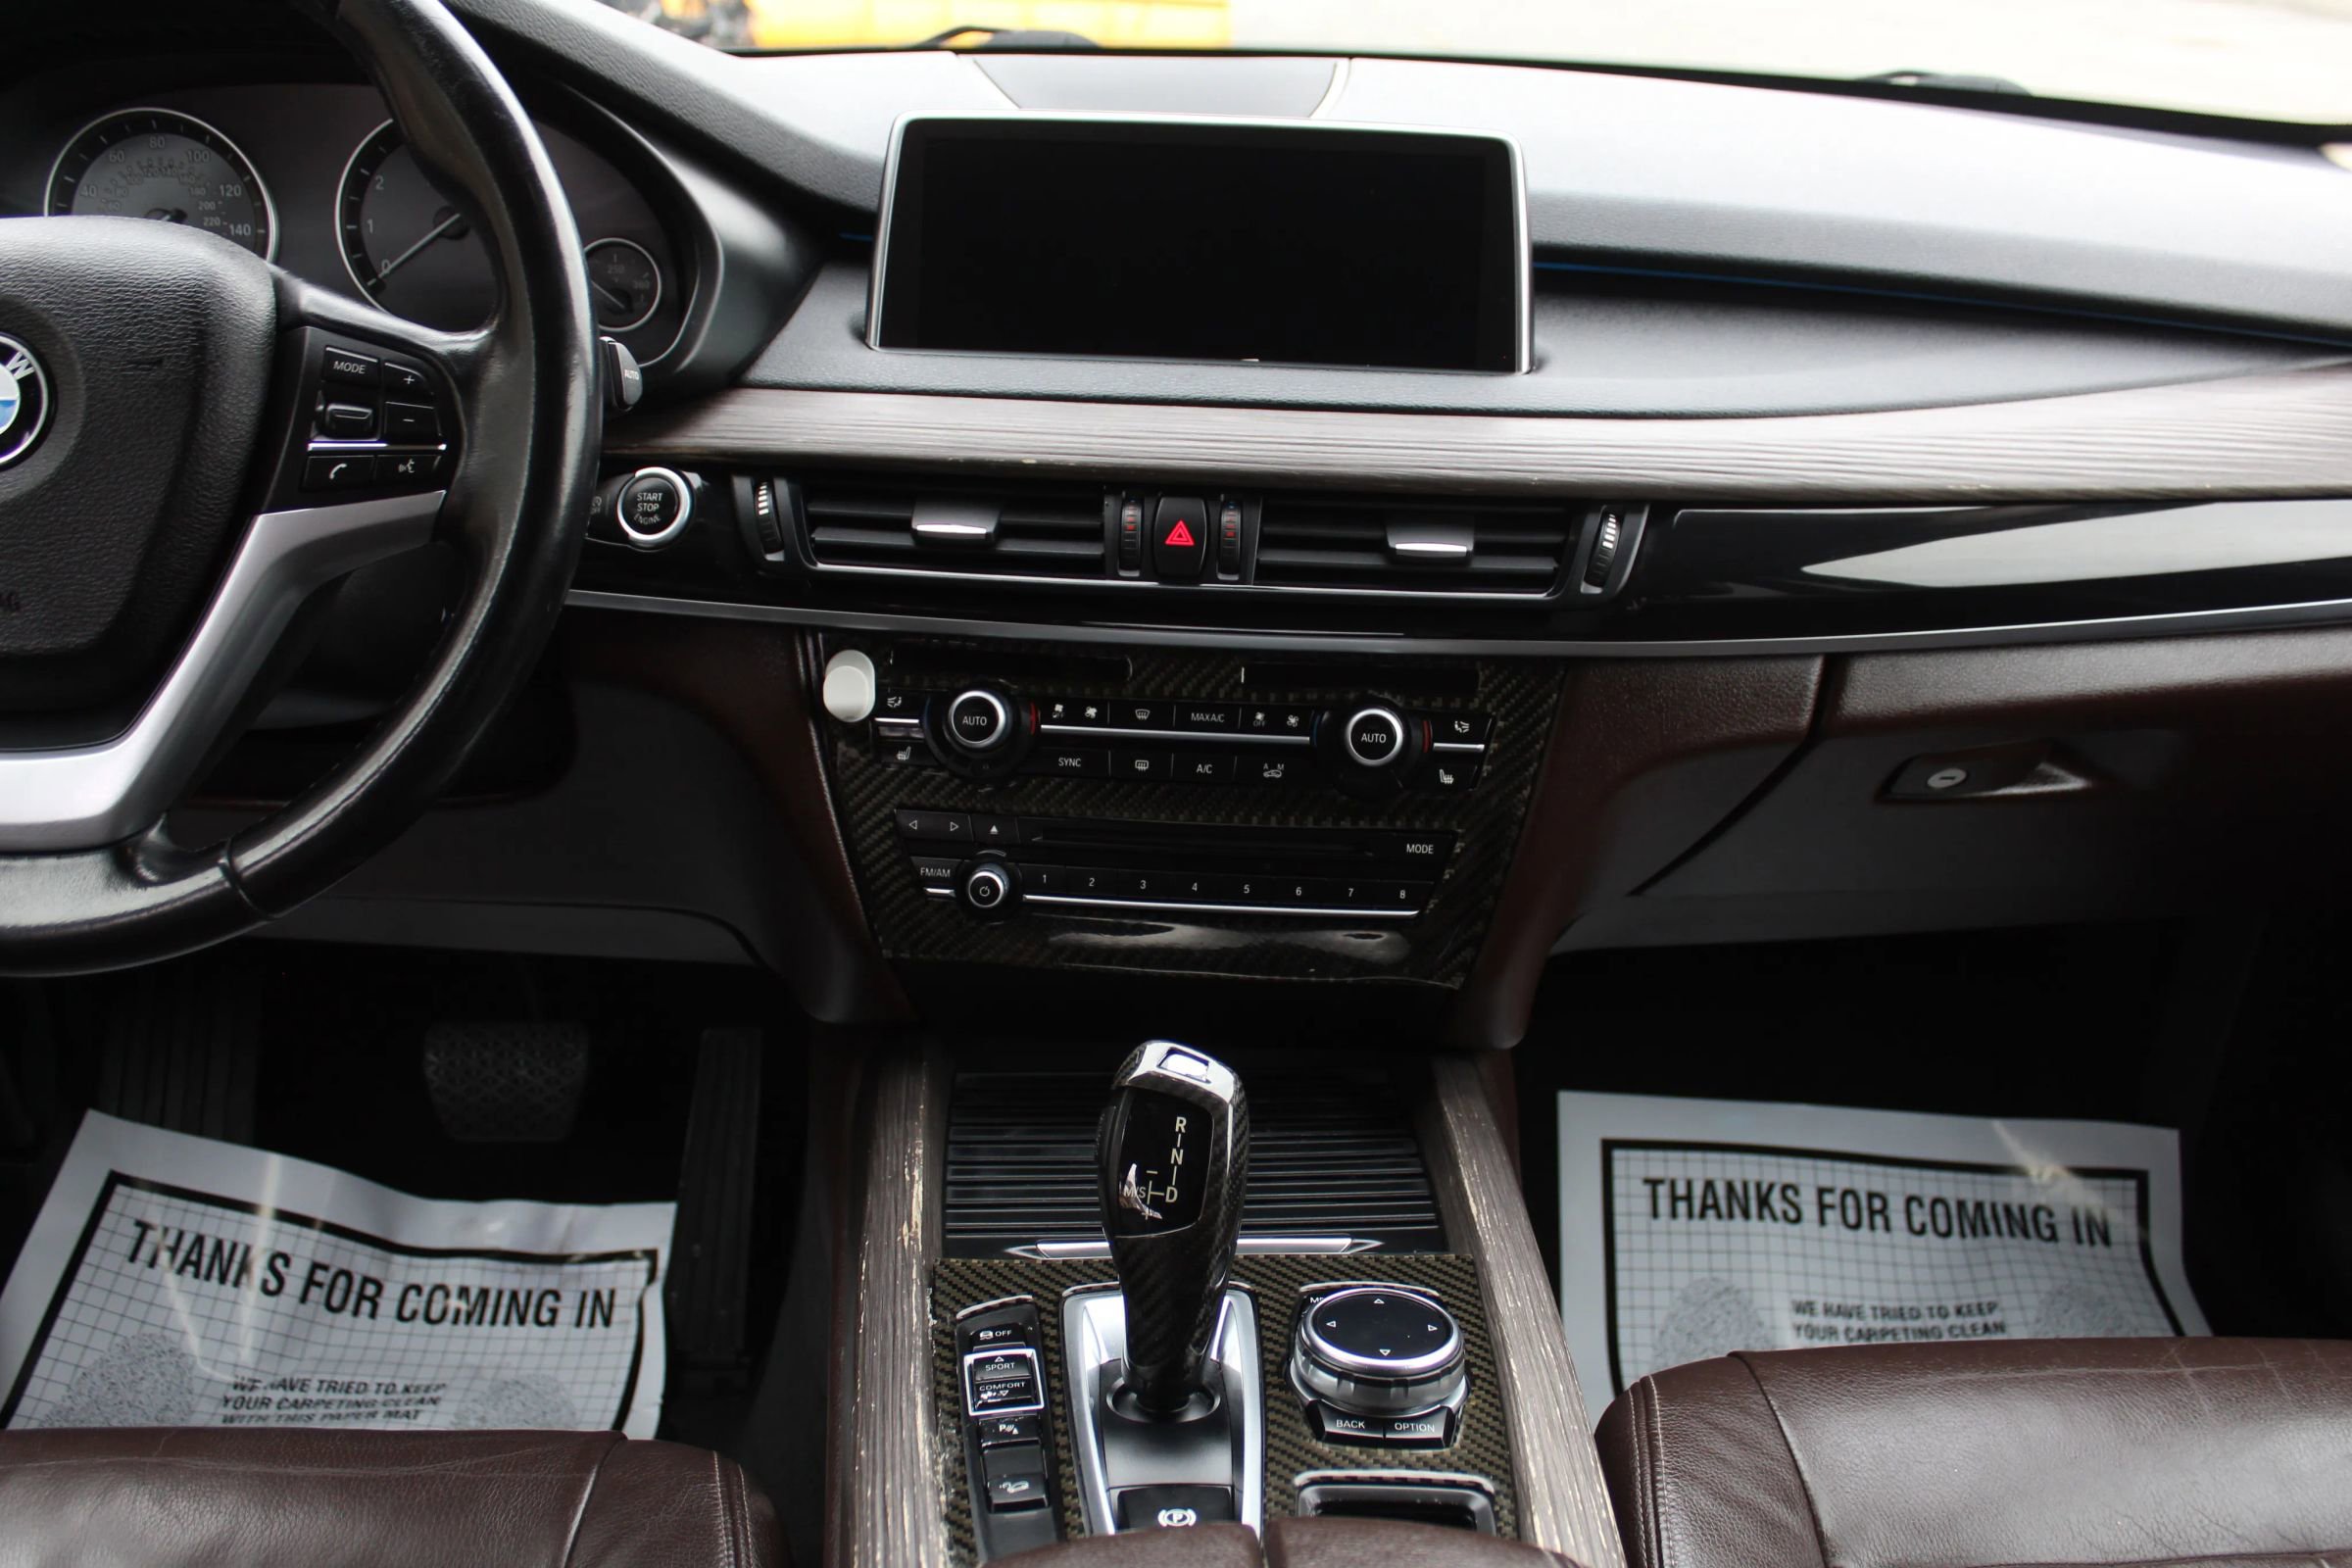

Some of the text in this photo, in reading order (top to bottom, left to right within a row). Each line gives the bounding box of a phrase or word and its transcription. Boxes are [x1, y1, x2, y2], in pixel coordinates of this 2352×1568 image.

[149, 136, 166, 148] 80
[109, 150, 125, 163] 60
[187, 150, 210, 163] 100
[374, 175, 384, 190] 2
[81, 185, 97, 197] 40
[220, 184, 242, 197] 120
[198, 201, 216, 211] 200
[204, 217, 220, 226] 220
[367, 219, 374, 234] 1
[229, 223, 251, 236] 140
[333, 360, 367, 374] MODE
[624, 368, 639, 380] AUTO
[636, 492, 663, 502] START
[637, 502, 660, 512] STOP
[633, 514, 662, 525] ENGINE
[961, 714, 988, 727] AUTO
[1360, 733, 1387, 744] AUTO
[1057, 757, 1082, 768] SYNC
[1196, 763, 1213, 774] A/C
[1406, 843, 1434, 855] MODE
[920, 867, 951, 878] FM/AM
[1042, 874, 1048, 883] 1
[1089, 877, 1095, 887] 2
[1140, 880, 1147, 890] 3
[1192, 882, 1199, 892] 4
[1244, 884, 1250, 894] 5
[1296, 887, 1302, 896] 6
[1348, 888, 1354, 898] 7
[1399, 889, 1406, 900] 8
[1175, 1116, 1187, 1134] R
[1170, 1148, 1184, 1165] N
[1123, 1187, 1147, 1199] M/S
[1165, 1186, 1179, 1203] D
[1642, 1178, 2112, 1248] THANKS FOR COMING IN
[127, 1219, 615, 1328] THANKS FOR COMING IN
[1791, 1299, 1998, 1321] WE HAVE TRIED TO KEEP
[995, 1329, 1012, 1338] OFF
[1793, 1321, 2007, 1343] YOUR CARPETING CLEAN
[985, 1362, 1016, 1372] SPORT
[316, 1379, 369, 1396] TRIED
[374, 1382, 396, 1396] TO
[401, 1383, 447, 1395] KEEP
[979, 1381, 1027, 1392] COMFORT
[222, 1395, 442, 1410] YOUR CARPETING CLEAN
[383, 1409, 422, 1421] MAT
[1336, 1419, 1365, 1429] BACK
[1394, 1423, 1436, 1433] OPTION
